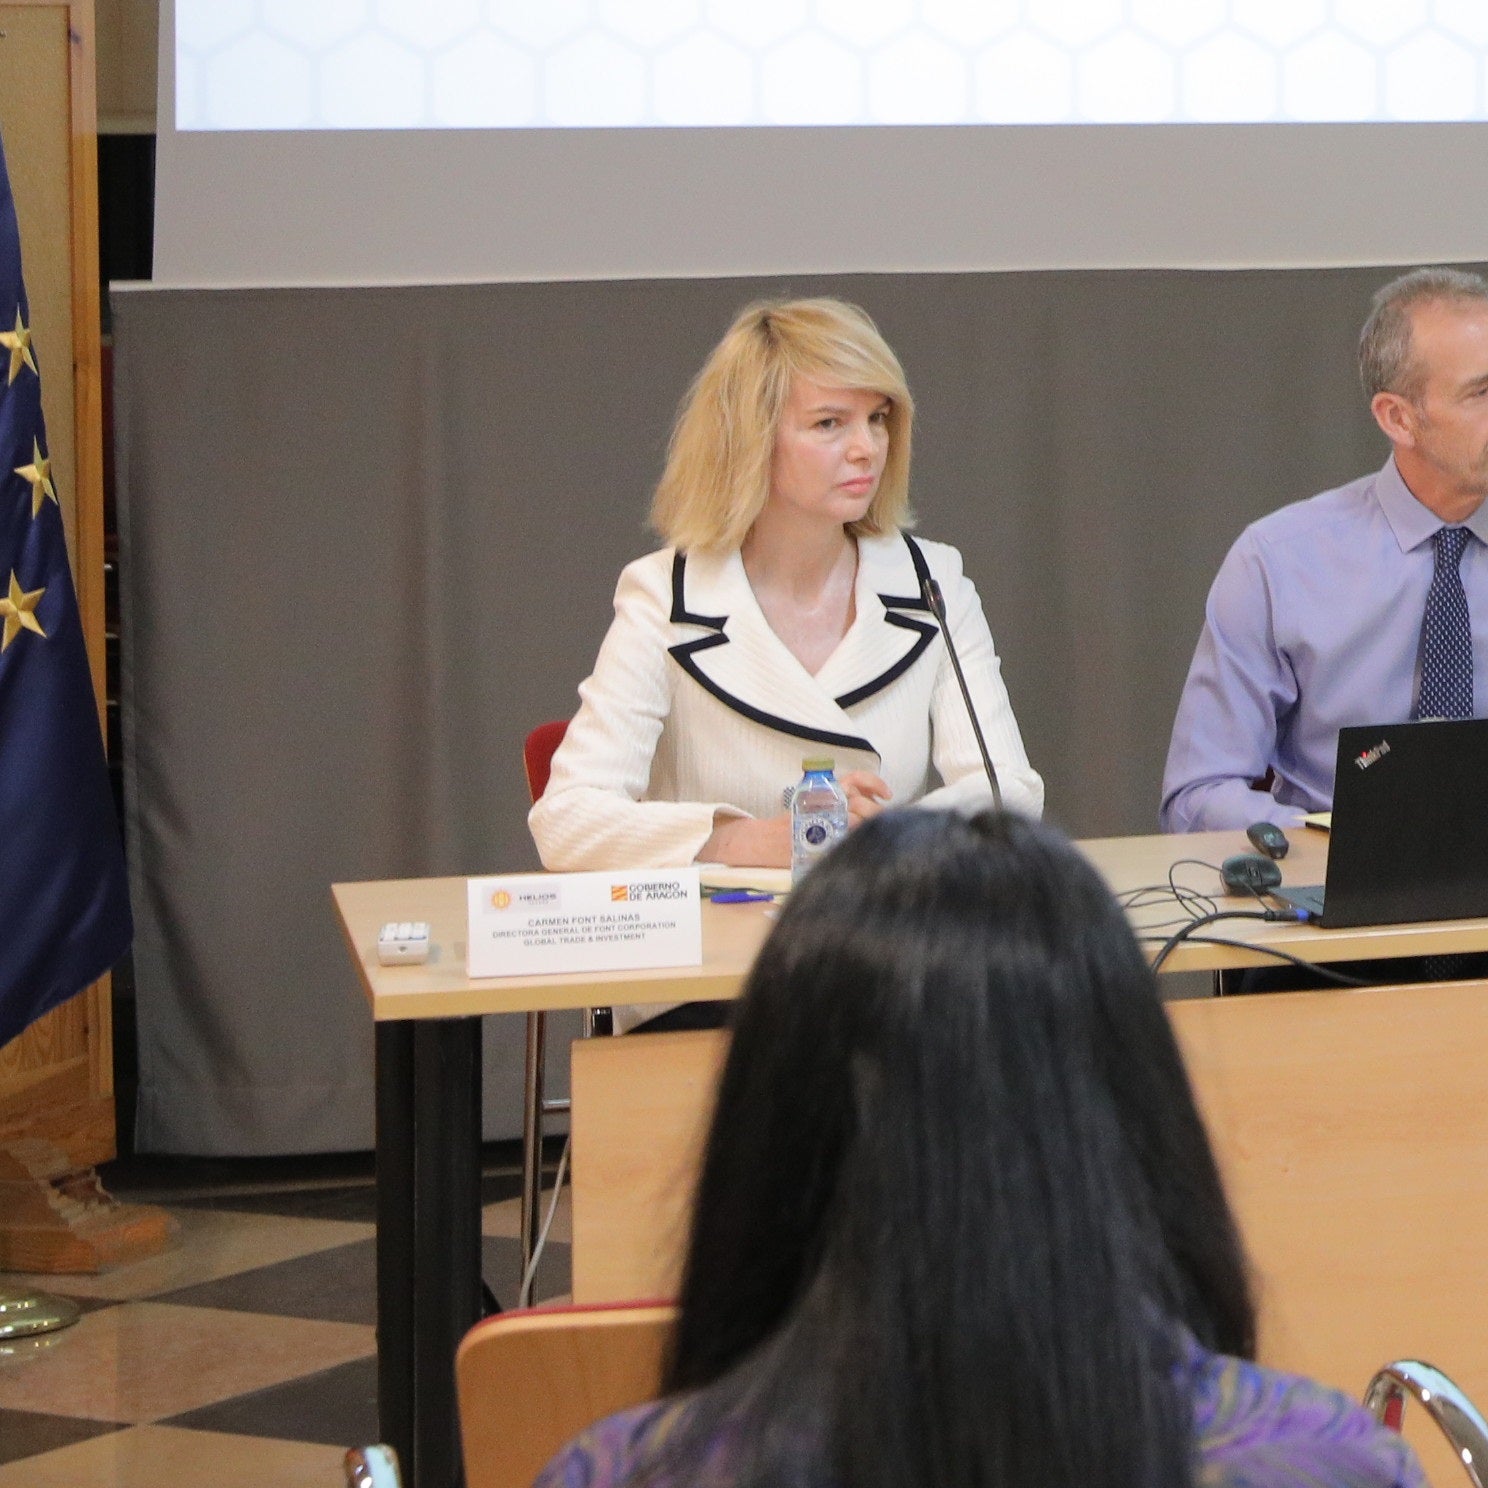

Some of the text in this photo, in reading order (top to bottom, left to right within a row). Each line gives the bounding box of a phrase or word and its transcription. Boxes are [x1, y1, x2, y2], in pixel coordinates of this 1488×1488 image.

[629, 881, 680, 892] GOBIERNO
[629, 891, 642, 901] DE
[528, 913, 641, 927] CARMEN FONT SALINAS
[492, 921, 676, 939] DIRECTORA GENERAL DE FONT CORPORATION
[523, 937, 557, 947] GLOBAL
[559, 935, 586, 945] TRADE
[595, 932, 646, 942] INVESTMENT
